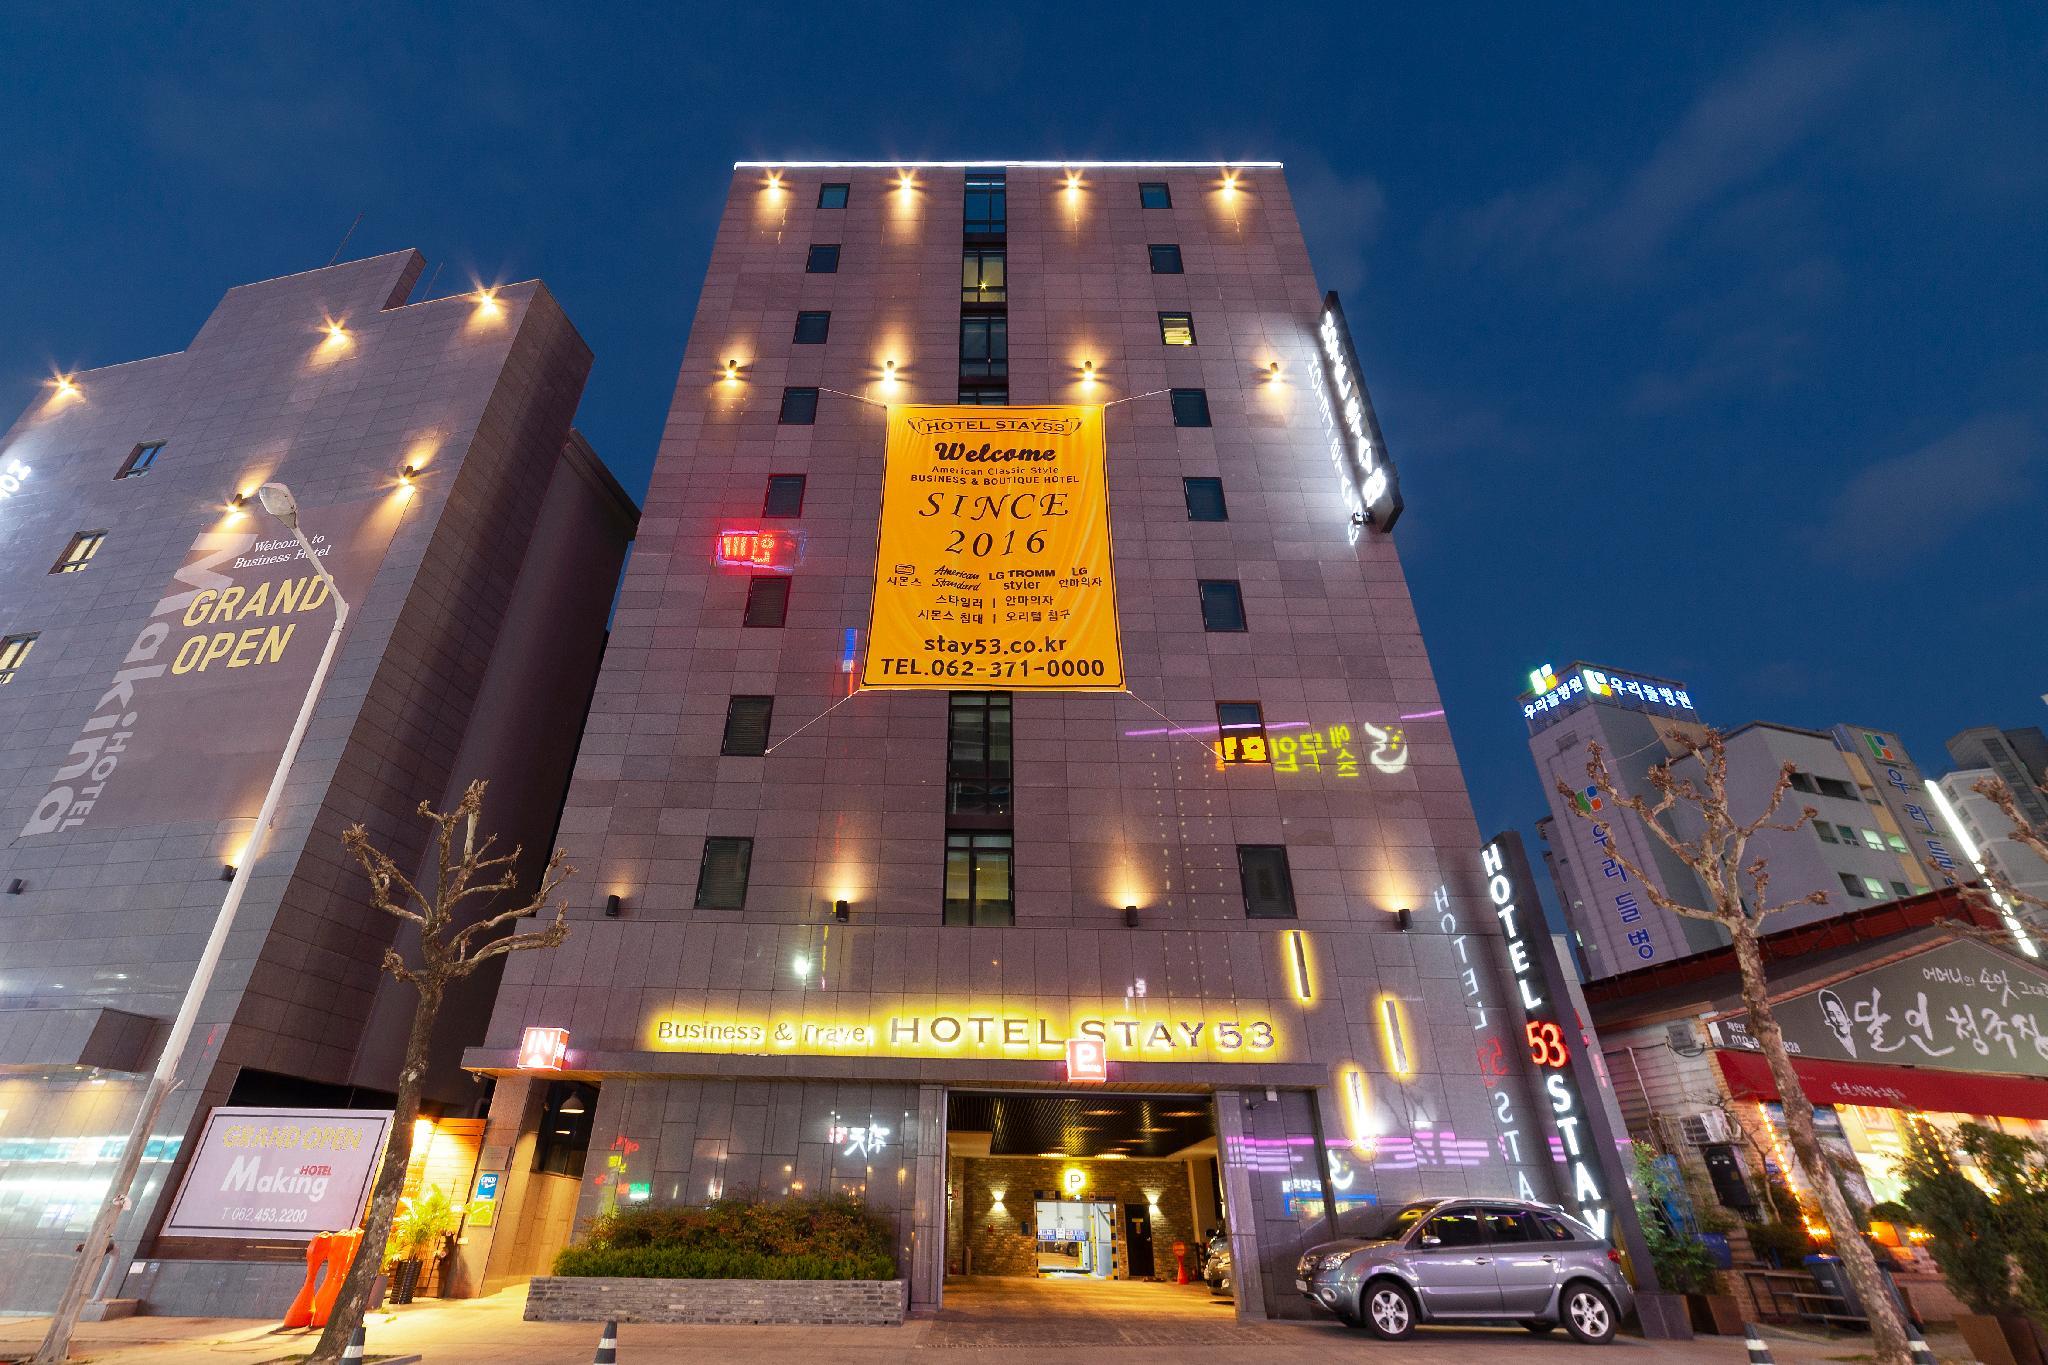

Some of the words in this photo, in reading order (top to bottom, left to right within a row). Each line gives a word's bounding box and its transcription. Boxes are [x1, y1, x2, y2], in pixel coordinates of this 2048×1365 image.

[927, 420, 990, 431] HOTEL
[995, 420, 1065, 432] STAY53
[934, 442, 1056, 462] Welcome
[911, 474, 966, 485] BUSINESS
[971, 477, 979, 486] &
[983, 476, 1039, 486] BOUTIQUE
[1044, 474, 1080, 484] HOTEL
[931, 466, 983, 476] American
[987, 467, 1025, 476] Classic
[1030, 466, 1059, 475] Style
[919, 492, 1069, 521] SINCE
[255, 538, 307, 552] Welcom
[312, 534, 325, 544] to
[945, 529, 1047, 557] 2016
[233, 552, 291, 569] Business
[887, 575, 922, 588] 시몬스
[934, 565, 980, 581] American
[988, 571, 1005, 581] LG
[1008, 568, 1056, 578] TROMM
[1072, 567, 1088, 576] LG
[932, 577, 980, 592] Standard
[1003, 579, 1041, 591] styler
[1058, 577, 1103, 589] 안마의자
[182, 574, 335, 628] GRAND
[935, 594, 983, 609] 스타일러
[1005, 595, 1054, 606] 안마의자
[918, 609, 954, 621] 시몬스
[960, 611, 983, 624] 침대
[1005, 610, 1042, 622] 오리털
[1048, 608, 1071, 621] 침구
[171, 622, 296, 675] OPEN
[924, 635, 1067, 656] stay53.co.kr
[881, 658, 1105, 678] TEL.062-371-0000
[19, 532, 258, 838] Making
[1610, 677, 1694, 710] 우리들병원
[1524, 675, 1585, 720] 우리들병원
[59, 730, 134, 832] HOTEL
[1888, 767, 1956, 886] 우리들
[1592, 824, 1655, 960] 우리들병
[1481, 843, 1541, 1010] HOTEL
[1923, 966, 1975, 988] 어머니의
[1980, 966, 2020, 1007] 손맛
[658, 1020, 760, 1040] Business
[774, 1022, 792, 1041] &
[891, 1016, 1064, 1044] HOTEL
[1081, 1020, 1206, 1048] STAY
[1218, 1021, 1275, 1049] 53
[1854, 987, 1955, 1058] 달인
[527, 1030, 555, 1055] IN
[1526, 1020, 1568, 1068] 53
[223, 1125, 301, 1149] GRAND
[302, 1126, 363, 1150] OPEN
[220, 1155, 329, 1202] Making
[300, 1165, 332, 1176] HOTEL
[1070, 1174, 1081, 1188] P
[221, 1207, 231, 1220] T
[232, 1207, 307, 1222] 062.453.2200
